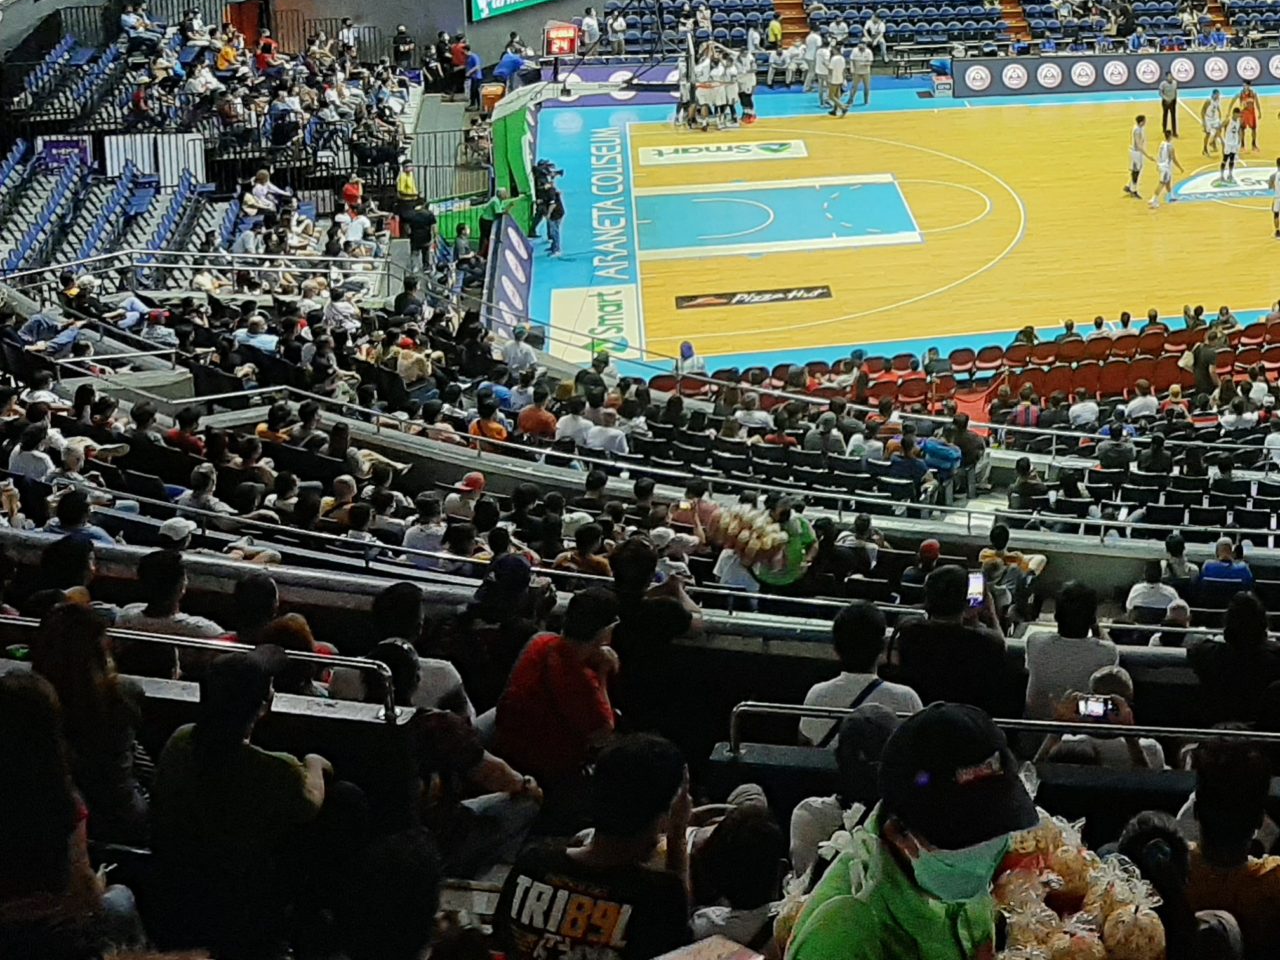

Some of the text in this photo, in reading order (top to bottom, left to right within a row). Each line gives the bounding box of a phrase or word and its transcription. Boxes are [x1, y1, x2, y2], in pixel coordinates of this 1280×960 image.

[652, 144, 753, 158] Smart
[590, 126, 630, 280] ARANETA COLISEUM
[730, 288, 828, 305] Pizza Hut
[588, 289, 626, 339] Smart
